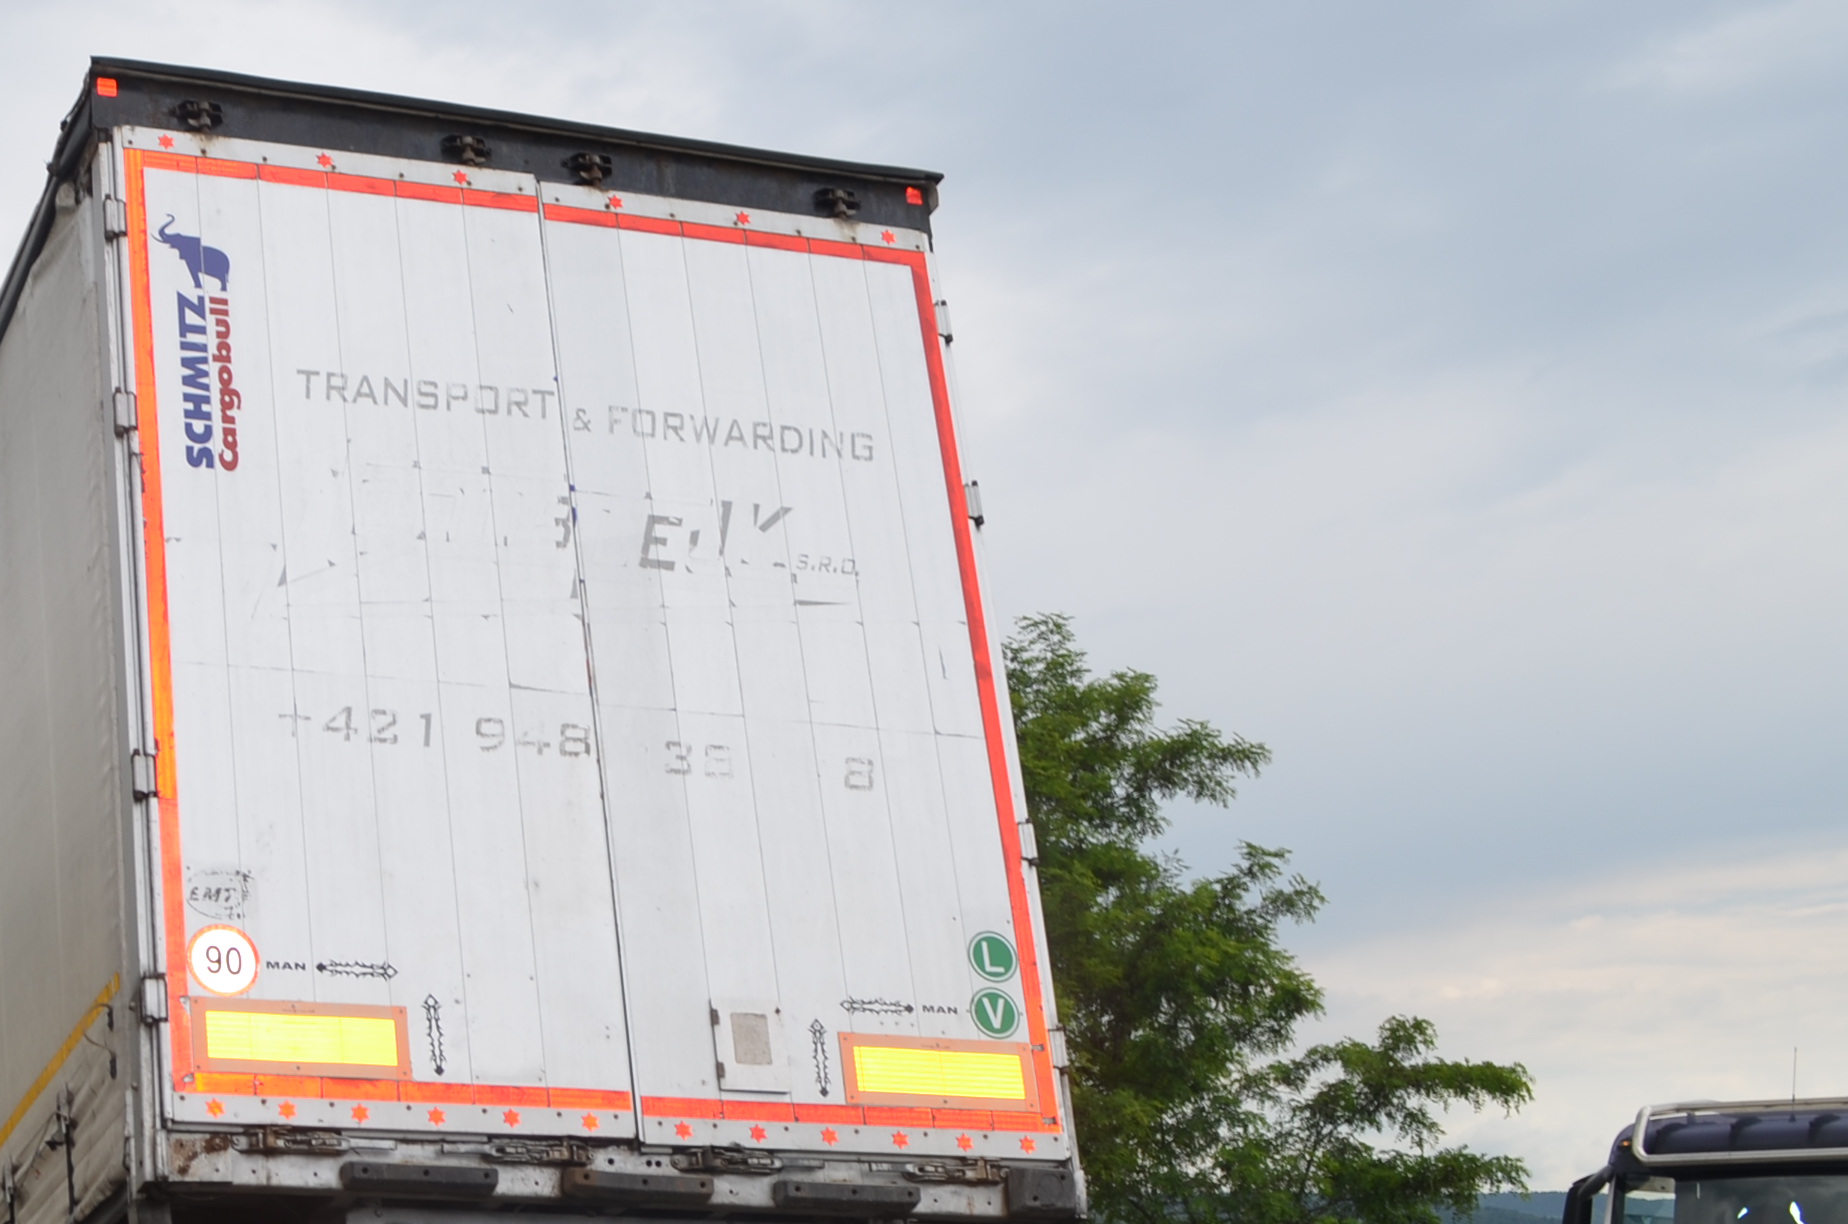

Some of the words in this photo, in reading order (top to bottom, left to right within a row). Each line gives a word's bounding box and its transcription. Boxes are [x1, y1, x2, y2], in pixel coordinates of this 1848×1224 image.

[176, 290, 215, 470] SCHMITZ
[208, 296, 242, 472] Cargobull
[296, 369, 555, 419] TRANSPORT
[572, 407, 592, 432] &
[608, 405, 874, 462] FORWARDING
[205, 944, 242, 975] 90
[265, 960, 307, 971] MAN
[980, 941, 1006, 973] L
[921, 1003, 959, 1015] MAN
[981, 997, 1006, 1029] V
